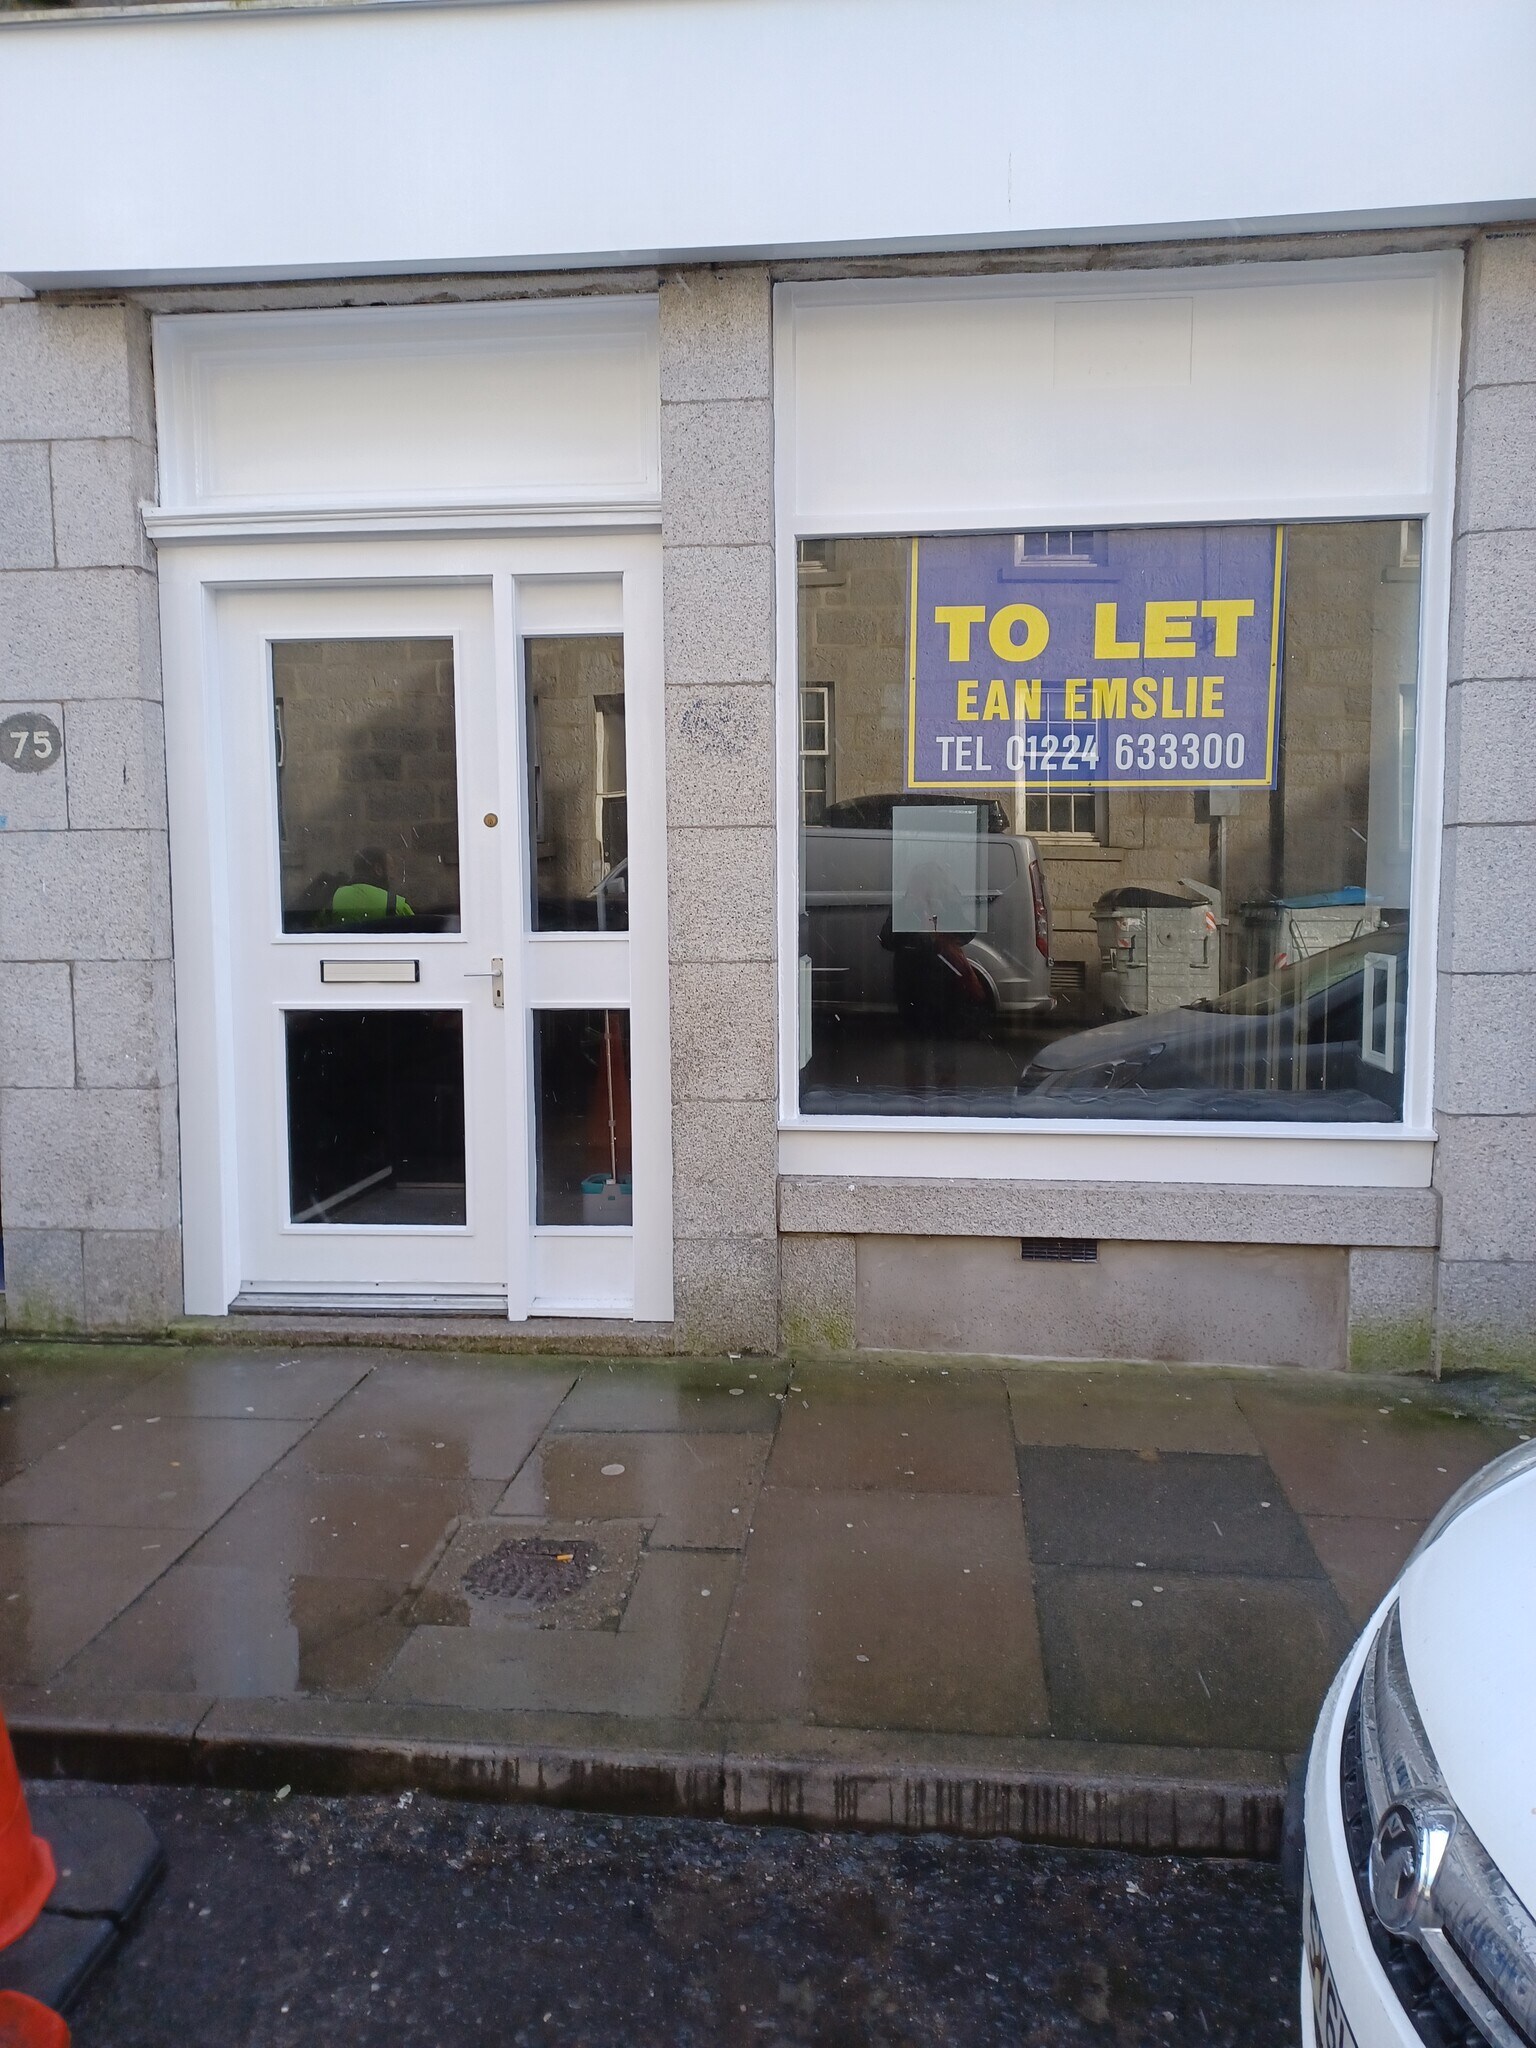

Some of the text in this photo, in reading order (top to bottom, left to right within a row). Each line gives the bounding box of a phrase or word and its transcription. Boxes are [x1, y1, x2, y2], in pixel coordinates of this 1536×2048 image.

[935, 599, 1255, 662] TO LET
[957, 676, 1225, 721] EAN EMSLIE
[10, 730, 52, 759] 75
[935, 732, 1245, 772] TEL 01224 633300
